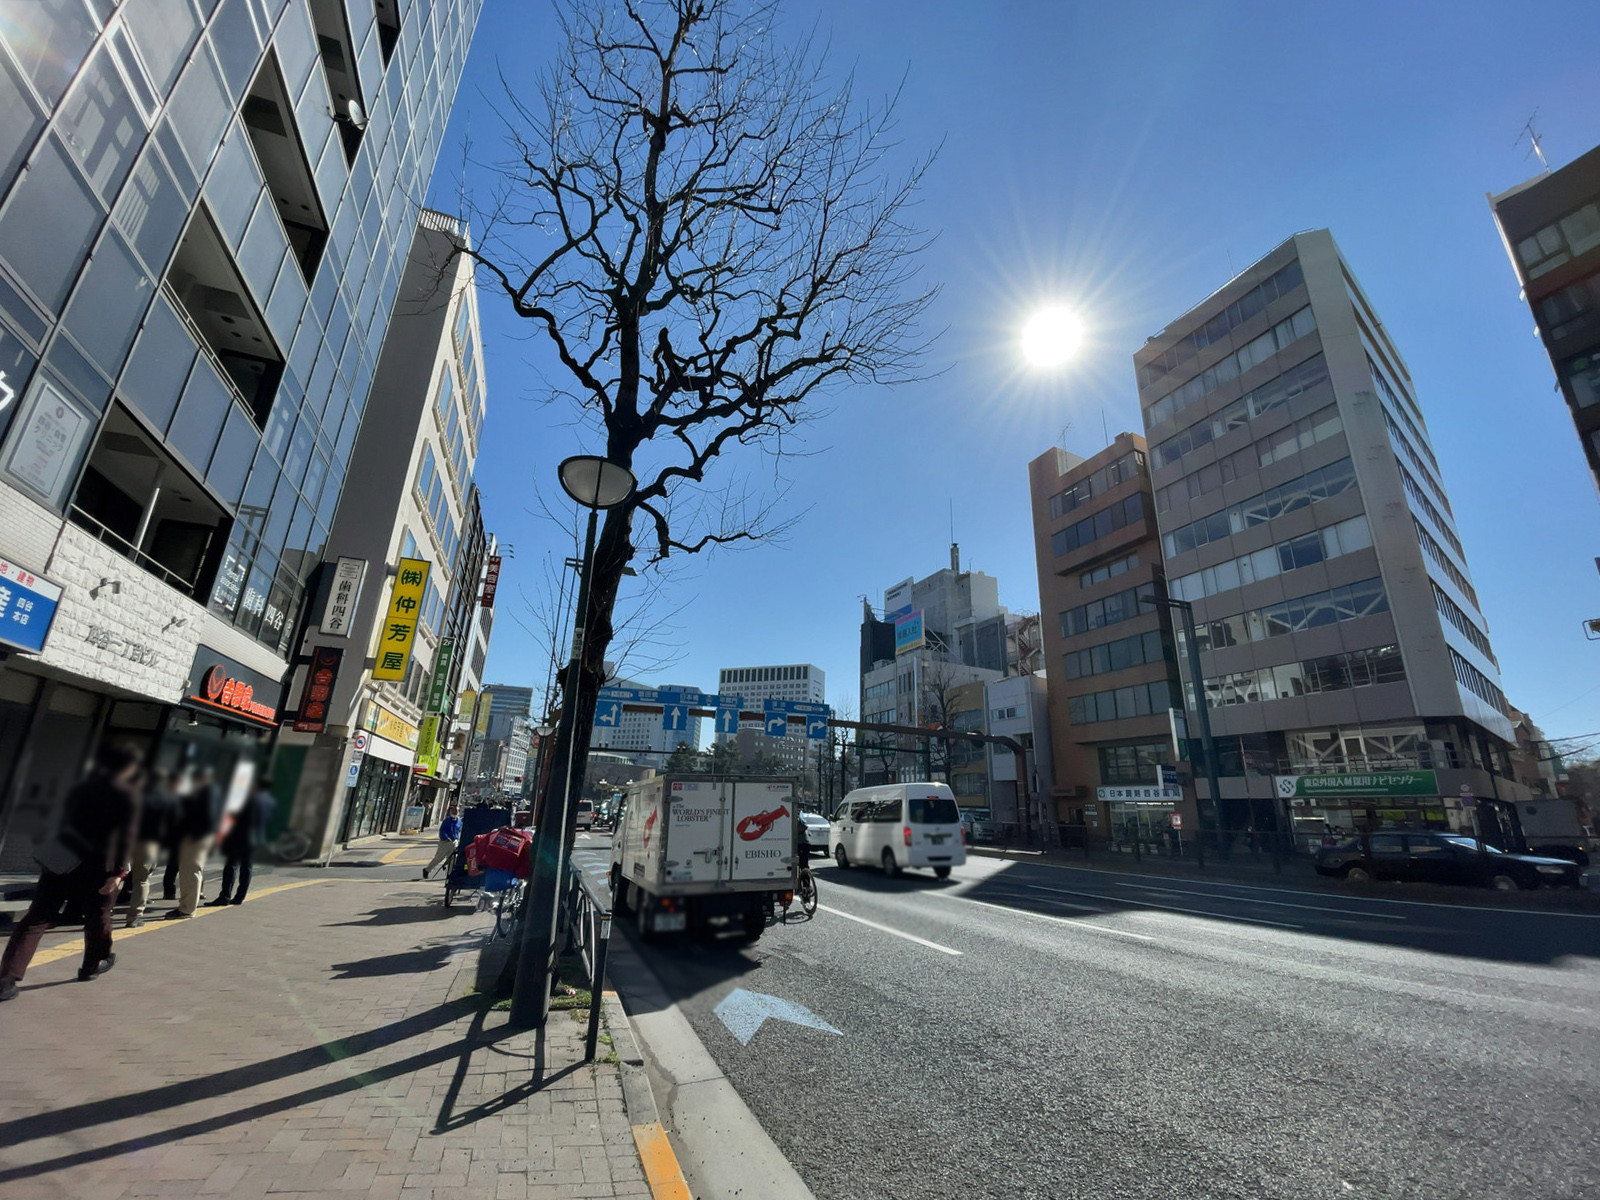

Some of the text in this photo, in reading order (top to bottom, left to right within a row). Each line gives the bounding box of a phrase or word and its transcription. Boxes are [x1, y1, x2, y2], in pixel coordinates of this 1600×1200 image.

[16, 597, 35, 613] 四谷
[330, 579, 352, 630] 歯科四谷
[12, 610, 31, 626] 本店
[443, 638, 452, 646] 2F
[672, 808, 730, 816] WORLD'S FINET
[745, 849, 782, 860] EBISHO
